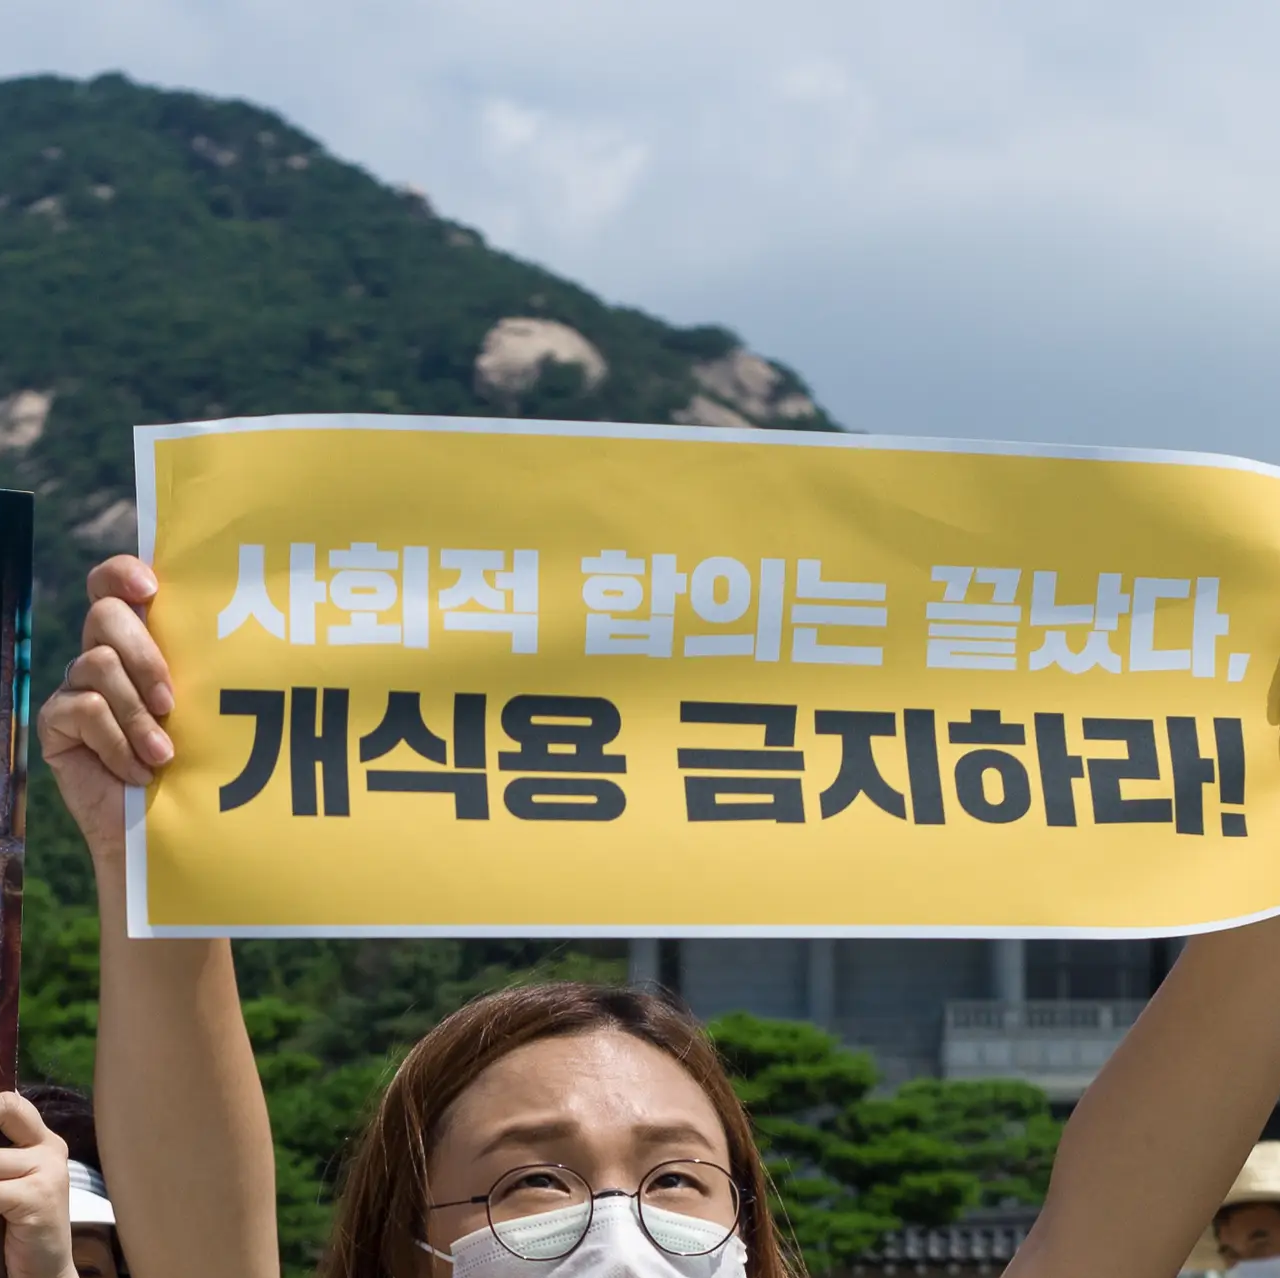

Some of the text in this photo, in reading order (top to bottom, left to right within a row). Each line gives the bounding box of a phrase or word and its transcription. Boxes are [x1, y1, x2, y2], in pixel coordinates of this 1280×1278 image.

[217, 541, 1250, 683] 사회적 합의는 끝났다,
[219, 686, 1248, 837] 개식용 금지하라!
